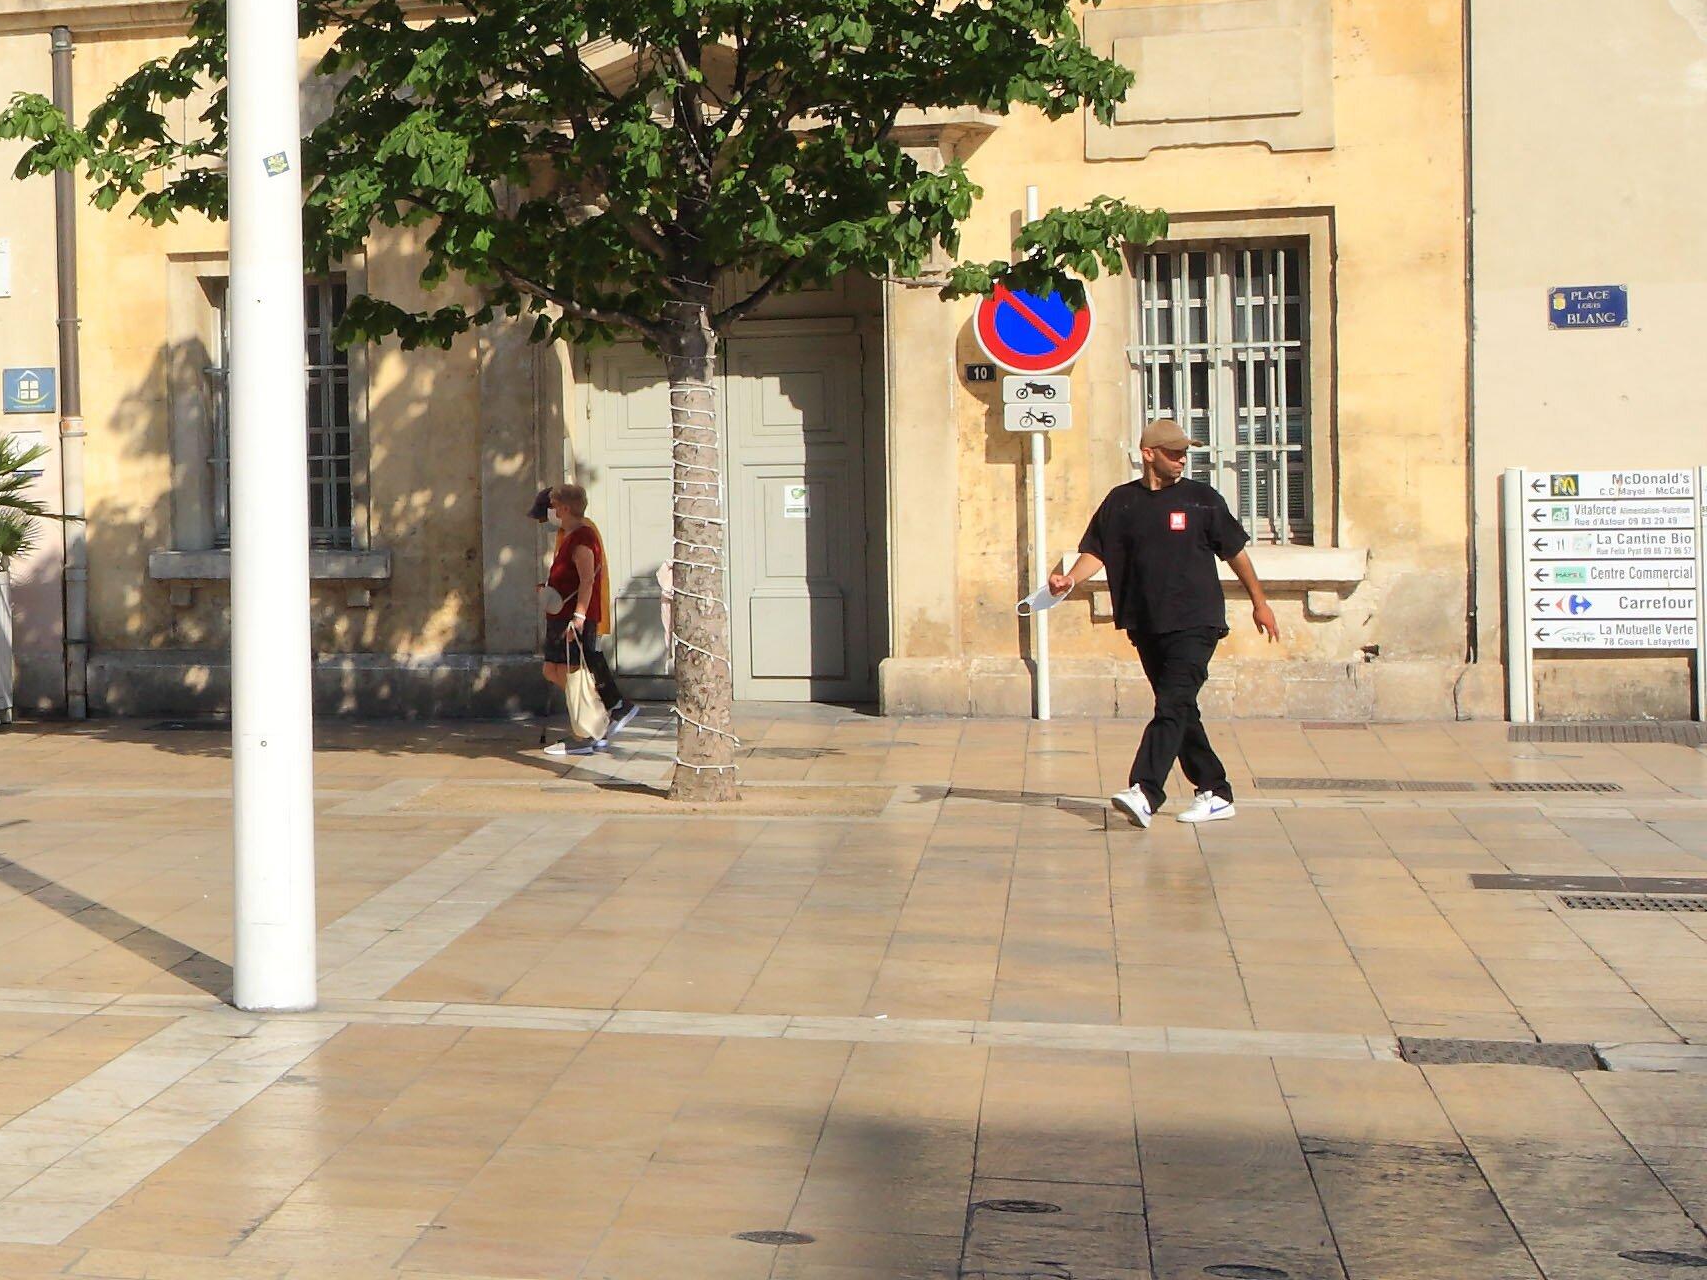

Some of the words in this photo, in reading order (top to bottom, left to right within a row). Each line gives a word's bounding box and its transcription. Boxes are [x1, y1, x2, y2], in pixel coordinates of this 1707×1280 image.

[1570, 290, 1611, 301] PLACE
[1567, 312, 1616, 325] BLANC
[973, 366, 988, 380] 10
[1612, 473, 1690, 485] McDonald's
[1574, 504, 1617, 515] Vitaforce
[1596, 533, 1612, 545] La
[1617, 533, 1666, 545] Cantine
[1671, 532, 1692, 544] Bio
[1590, 566, 1625, 580] Centre
[1628, 566, 1693, 580] Commercial
[1619, 596, 1694, 610] Carrefour
[1599, 624, 1612, 635] La
[1615, 623, 1661, 636] Mutuelle
[1665, 623, 1694, 635] Verte
